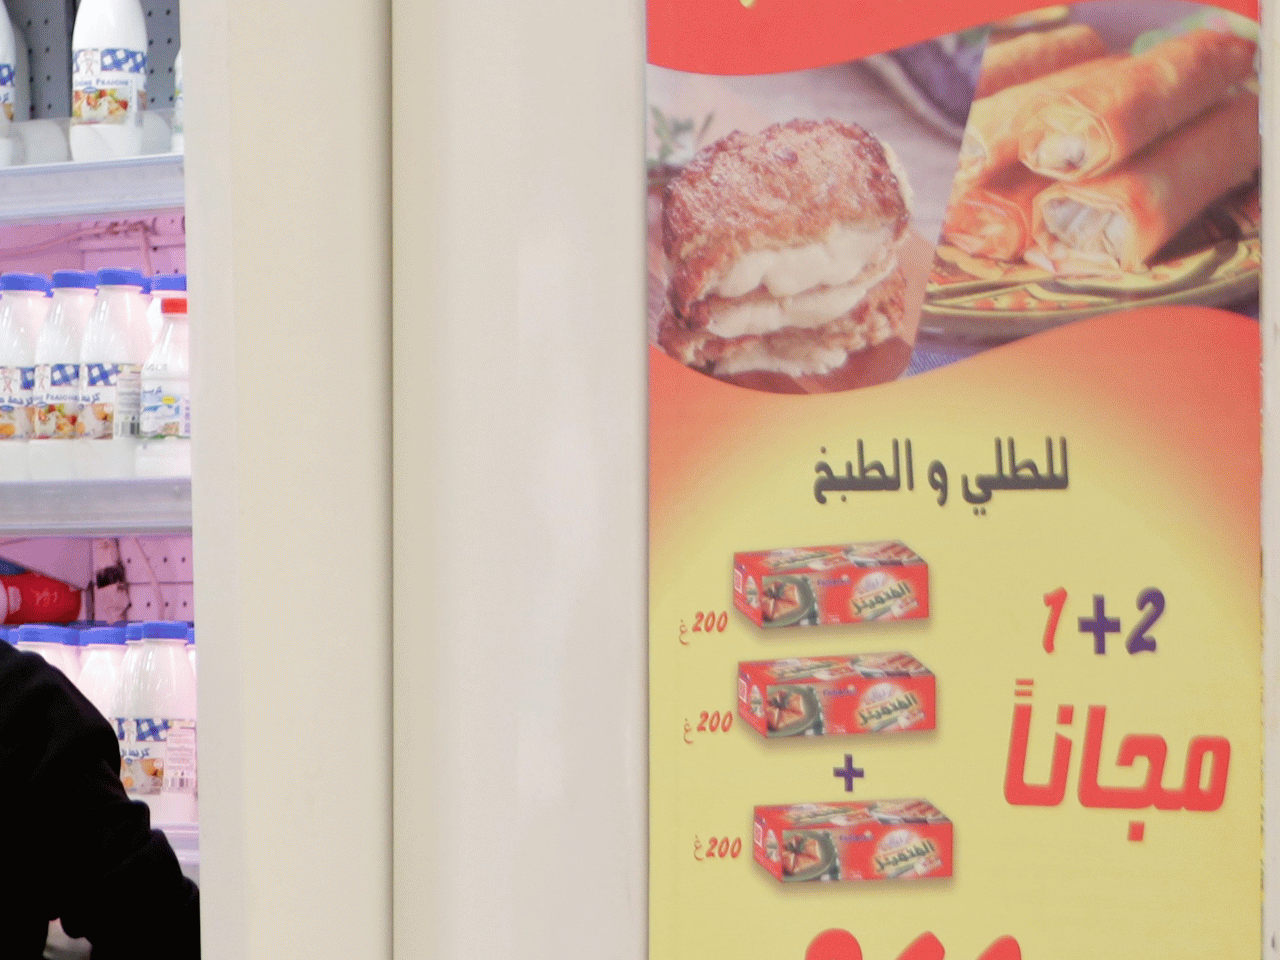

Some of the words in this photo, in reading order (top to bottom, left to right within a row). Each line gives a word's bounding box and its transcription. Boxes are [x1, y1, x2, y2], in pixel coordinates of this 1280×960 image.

[813, 438, 915, 505] الطبخ
[927, 458, 949, 506] و
[961, 436, 1070, 516] للطلي
[692, 610, 728, 634] 200
[696, 710, 734, 735] 200
[706, 836, 743, 860] 200
